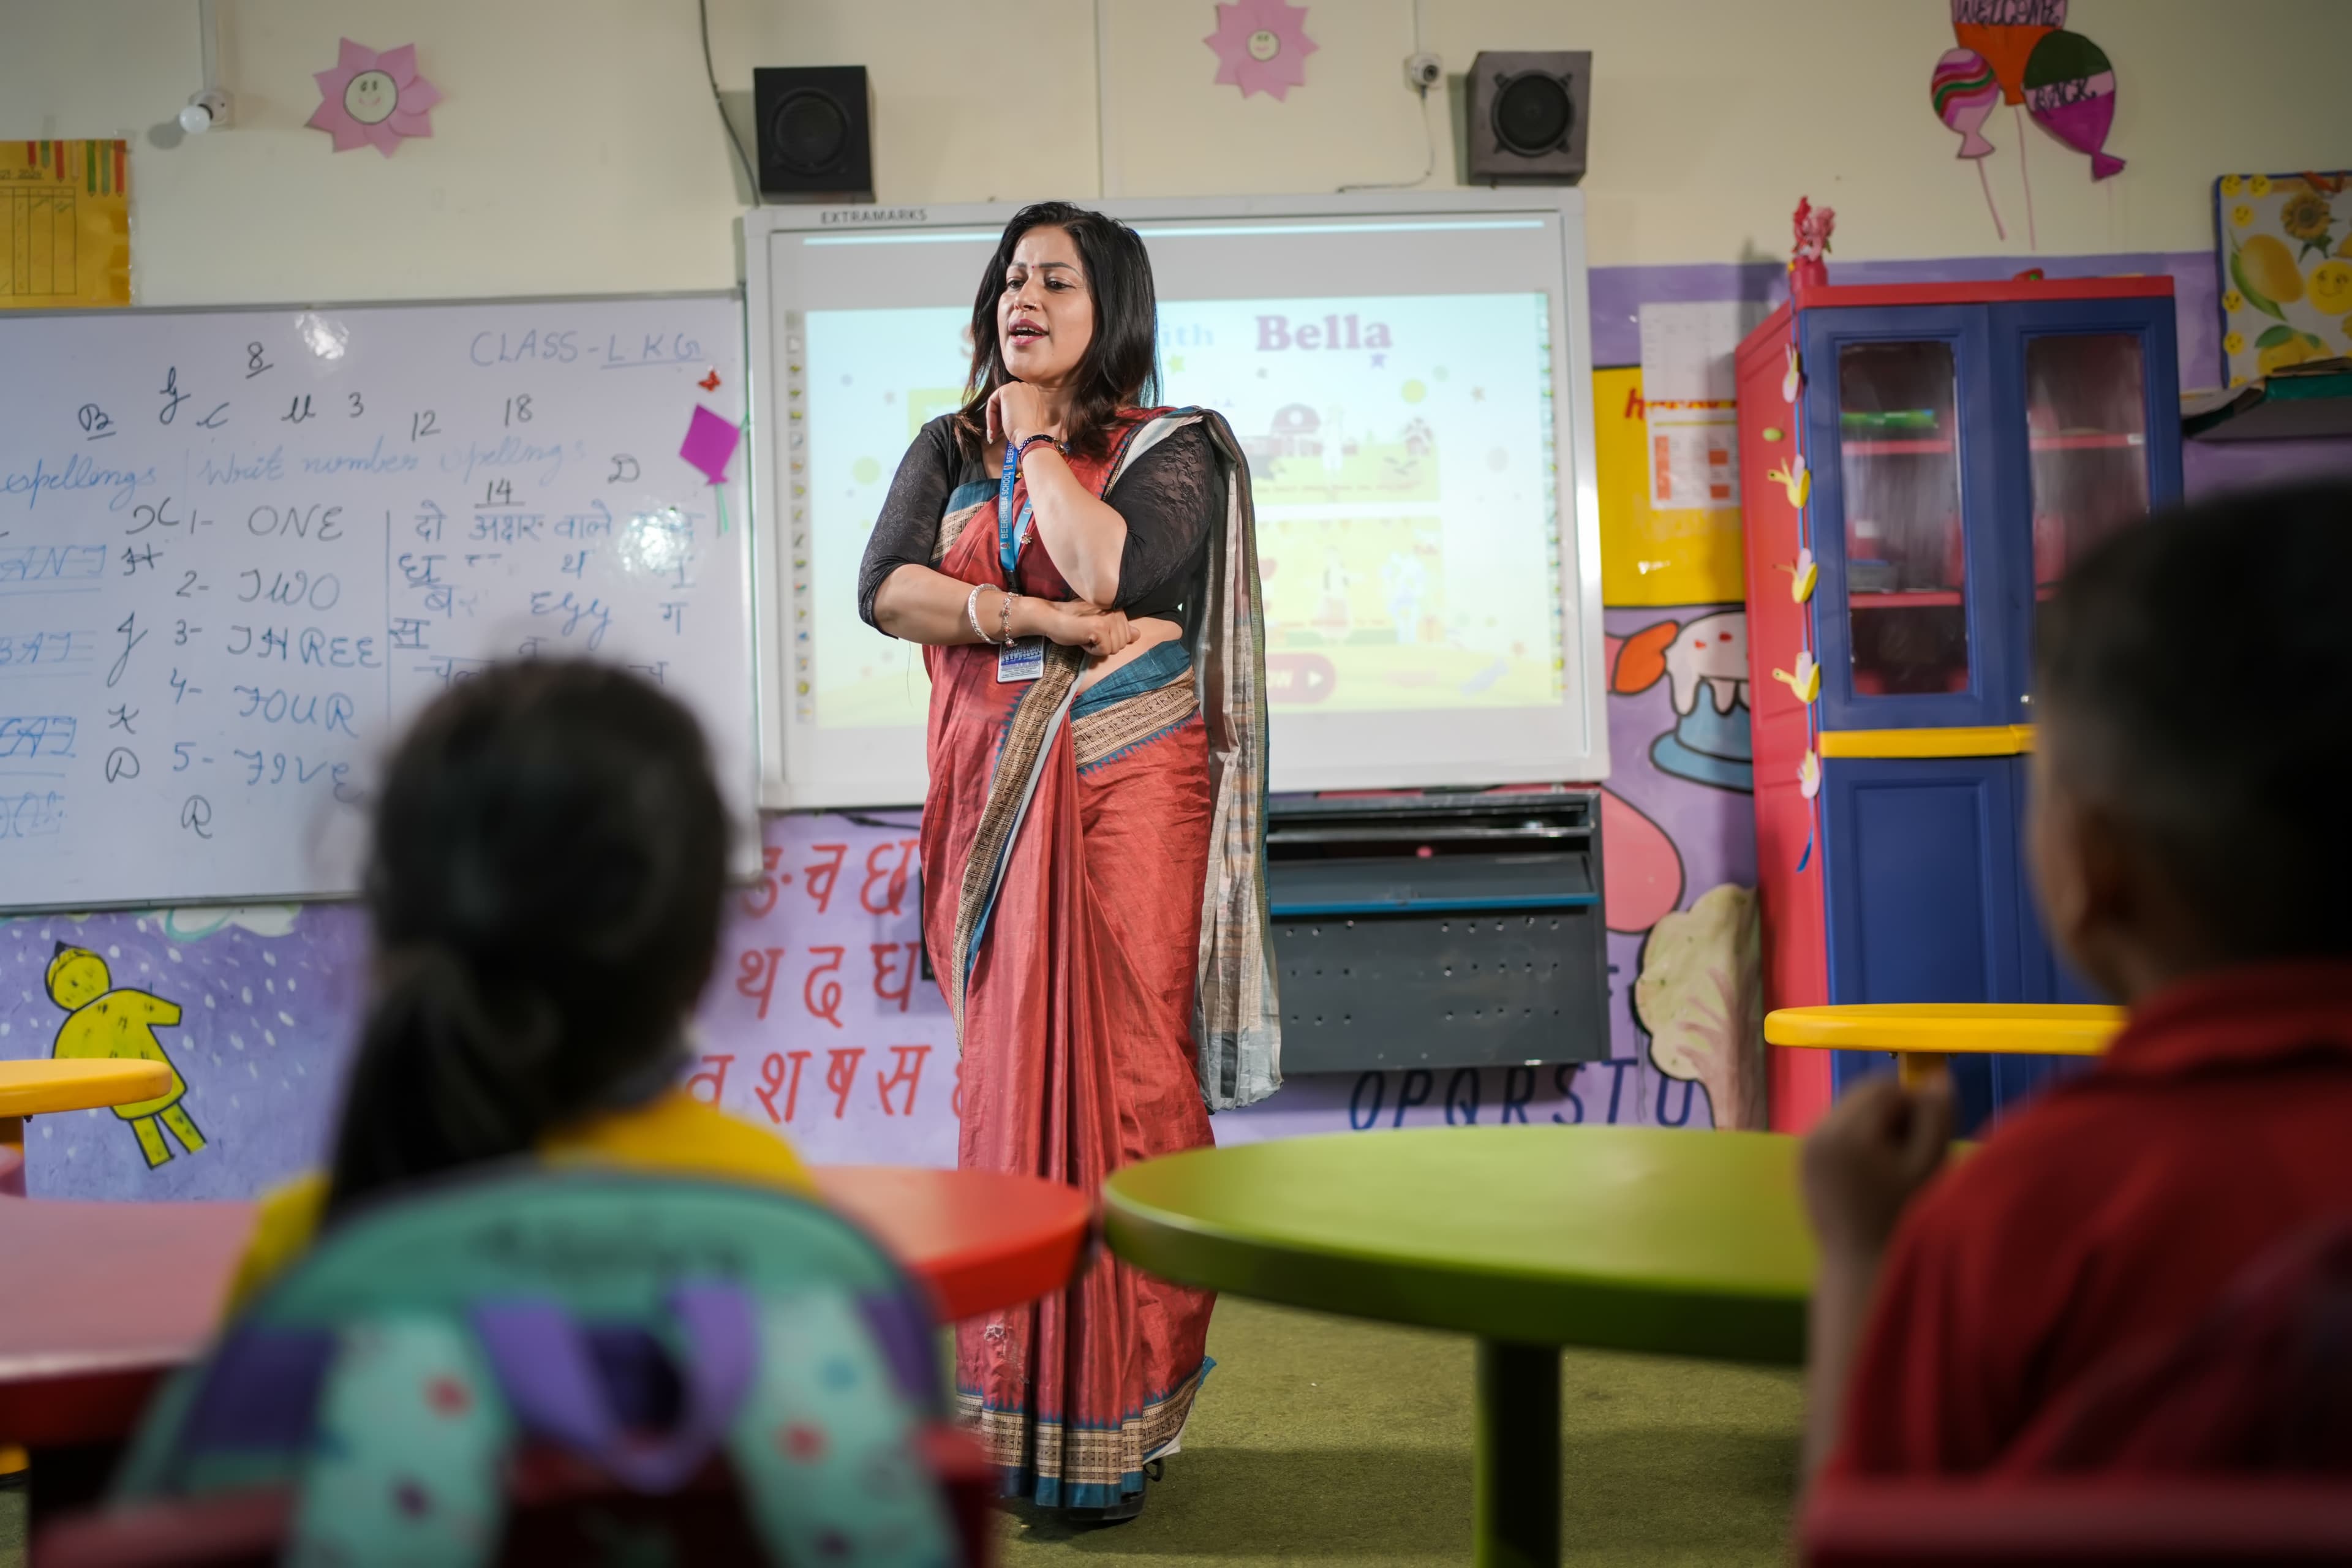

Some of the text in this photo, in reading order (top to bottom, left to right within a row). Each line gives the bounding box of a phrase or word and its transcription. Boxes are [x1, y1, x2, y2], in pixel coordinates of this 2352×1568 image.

[821, 209, 927, 224] EXTRAMARKS
[1255, 314, 1392, 351] Bella
[411, 410, 441, 442] 12
[504, 393, 533, 428] 18
[486, 478, 513, 504] 14
[1001, 472, 1012, 495] SCHOOL
[247, 505, 344, 542] ONE
[1000, 496, 1009, 540] BEERSHEBA
[238, 569, 341, 611] TWO
[227, 625, 383, 669] THREE
[233, 685, 360, 739] FOUR
[233, 748, 364, 805] FIVE
